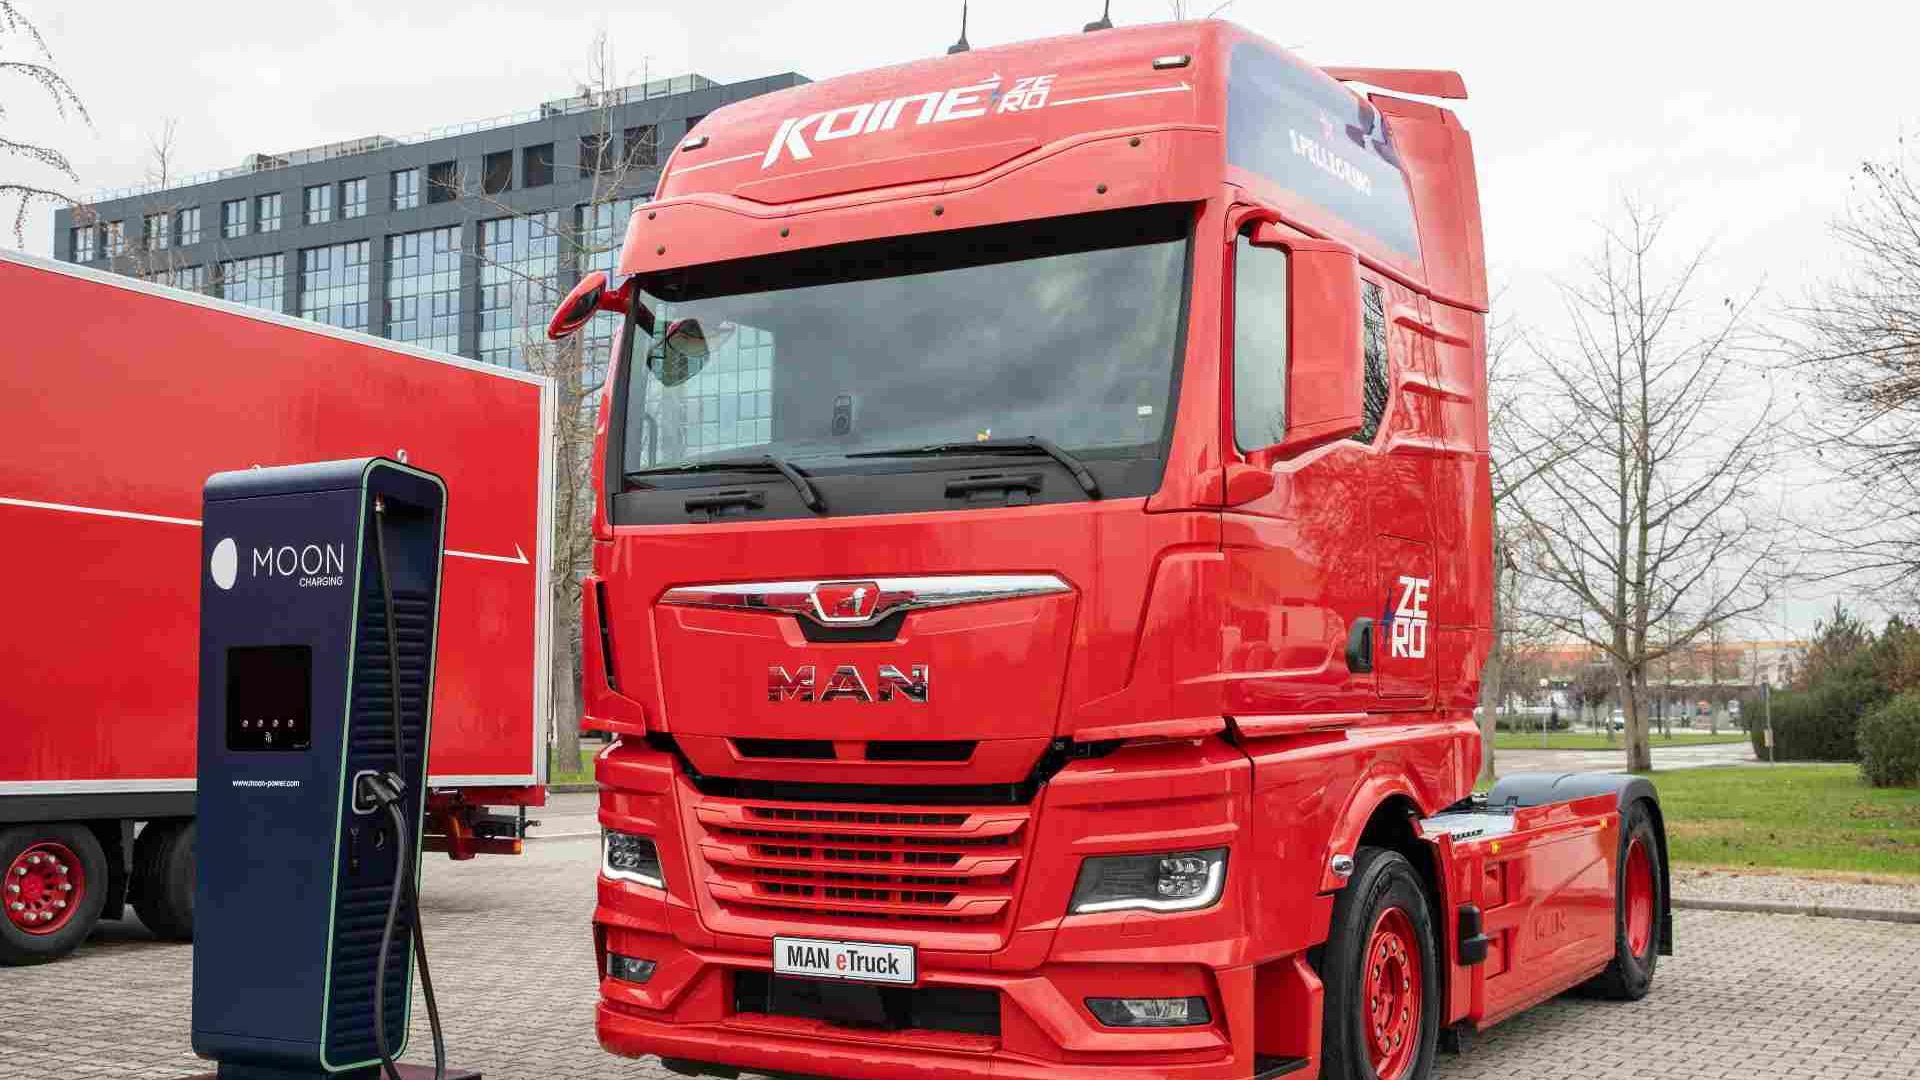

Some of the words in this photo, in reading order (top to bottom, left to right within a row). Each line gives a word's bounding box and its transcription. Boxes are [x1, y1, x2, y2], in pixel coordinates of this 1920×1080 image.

[1006, 74, 1058, 94] ZE
[997, 90, 1050, 114] RO
[253, 543, 345, 577] MOON
[299, 576, 344, 588] CHARGING
[1394, 575, 1431, 618] ZE
[1391, 616, 1428, 659] RO
[767, 664, 929, 702] MAN
[232, 779, 300, 788] www.moon-power.com
[786, 945, 830, 969] MAN
[835, 949, 900, 975] eTruck
